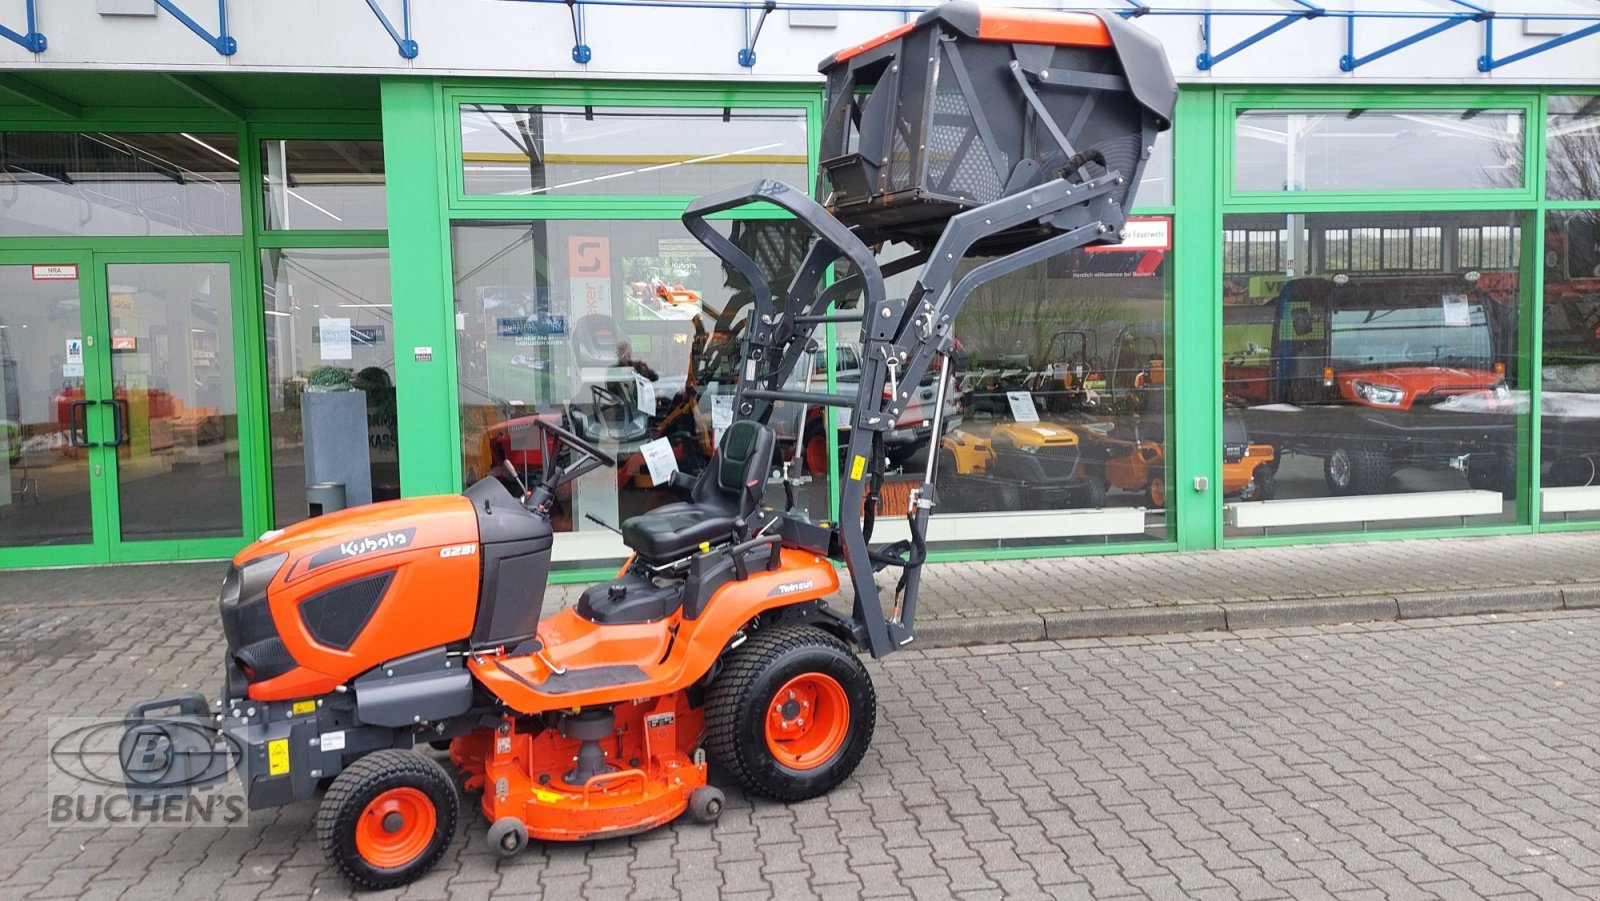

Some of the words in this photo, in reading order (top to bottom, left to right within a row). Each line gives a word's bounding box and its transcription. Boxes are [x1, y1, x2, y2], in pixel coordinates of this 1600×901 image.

[1133, 231, 1165, 239] Feuerwehr
[340, 532, 407, 556] Kubota
[440, 544, 477, 558] G231
[779, 583, 798, 593] Twin
